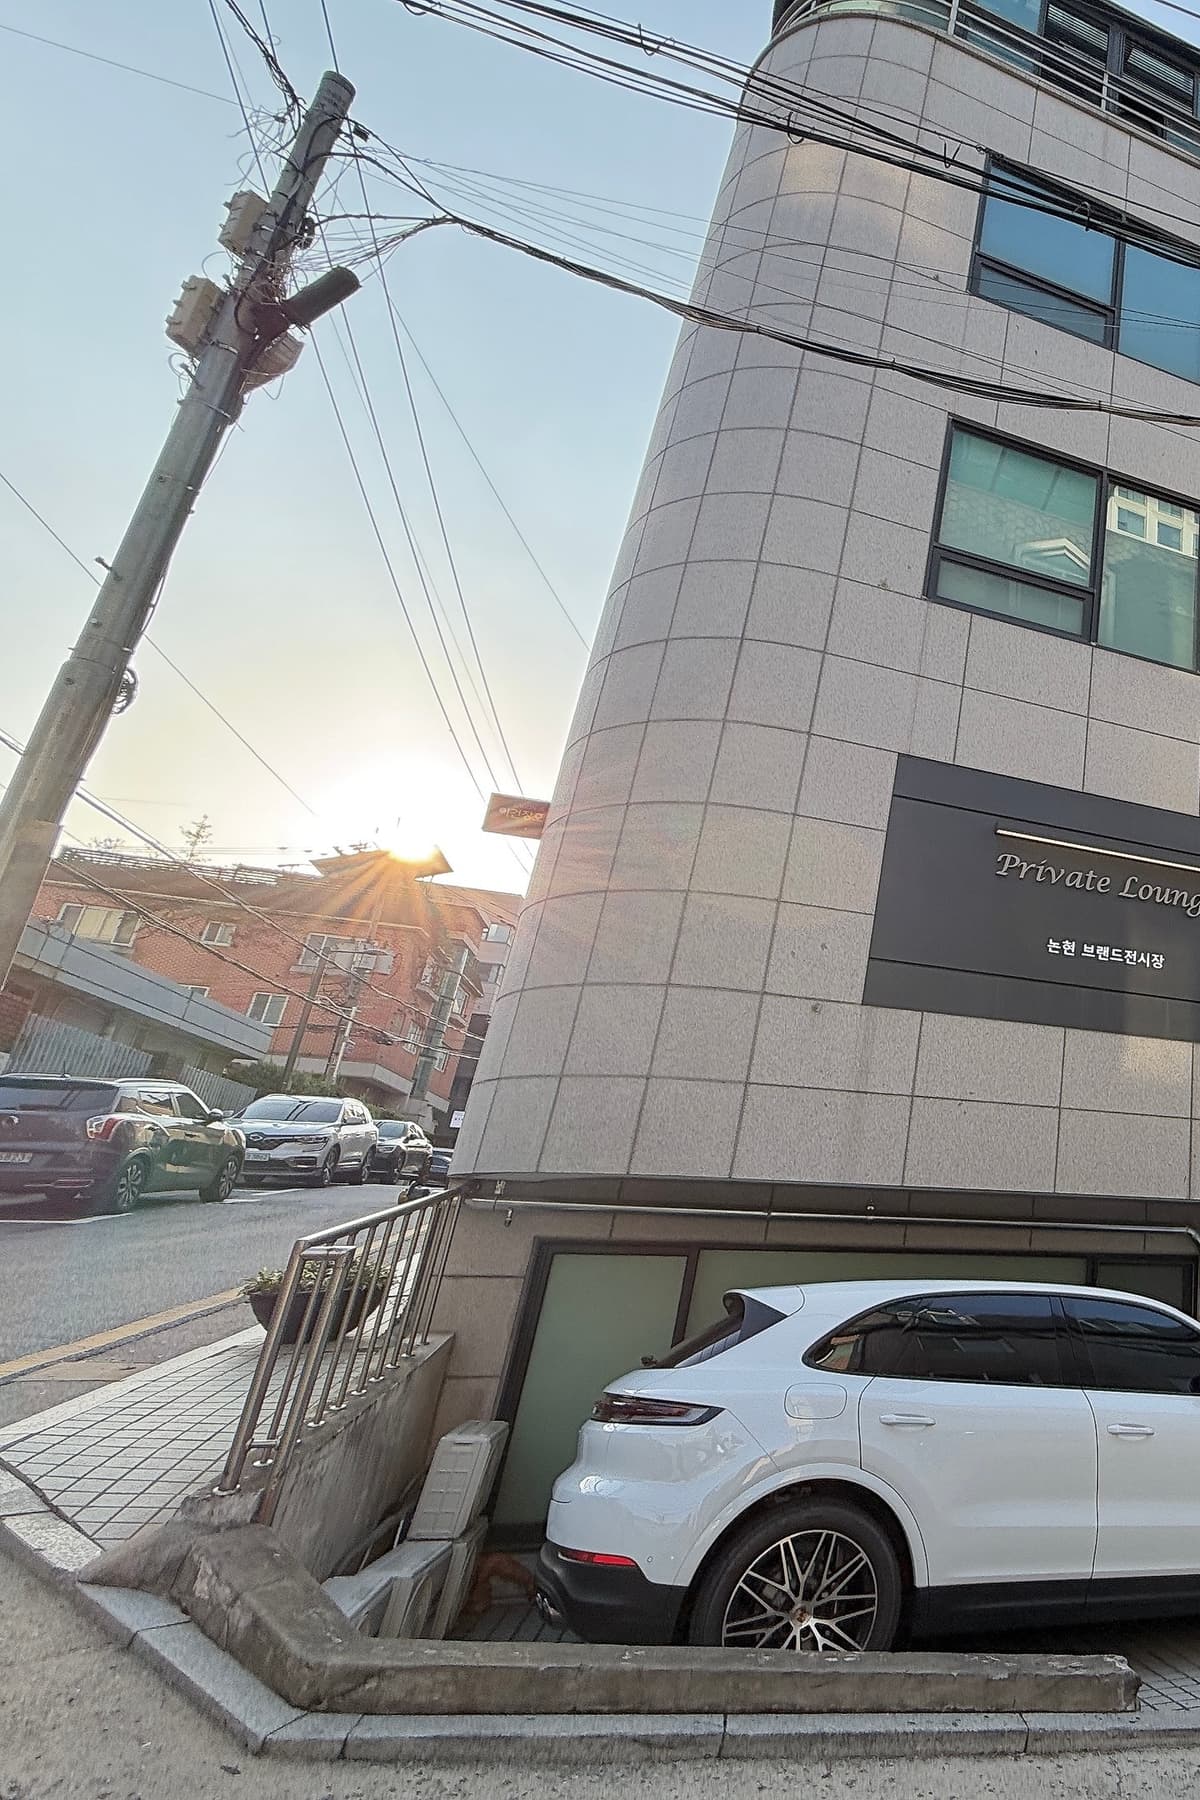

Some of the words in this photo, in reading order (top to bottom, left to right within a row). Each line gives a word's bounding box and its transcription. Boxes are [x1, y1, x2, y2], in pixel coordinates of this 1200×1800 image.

[996, 853, 1111, 893] Private
[1047, 938, 1076, 957] 논현
[1081, 943, 1165, 969] 브랜드전시장
